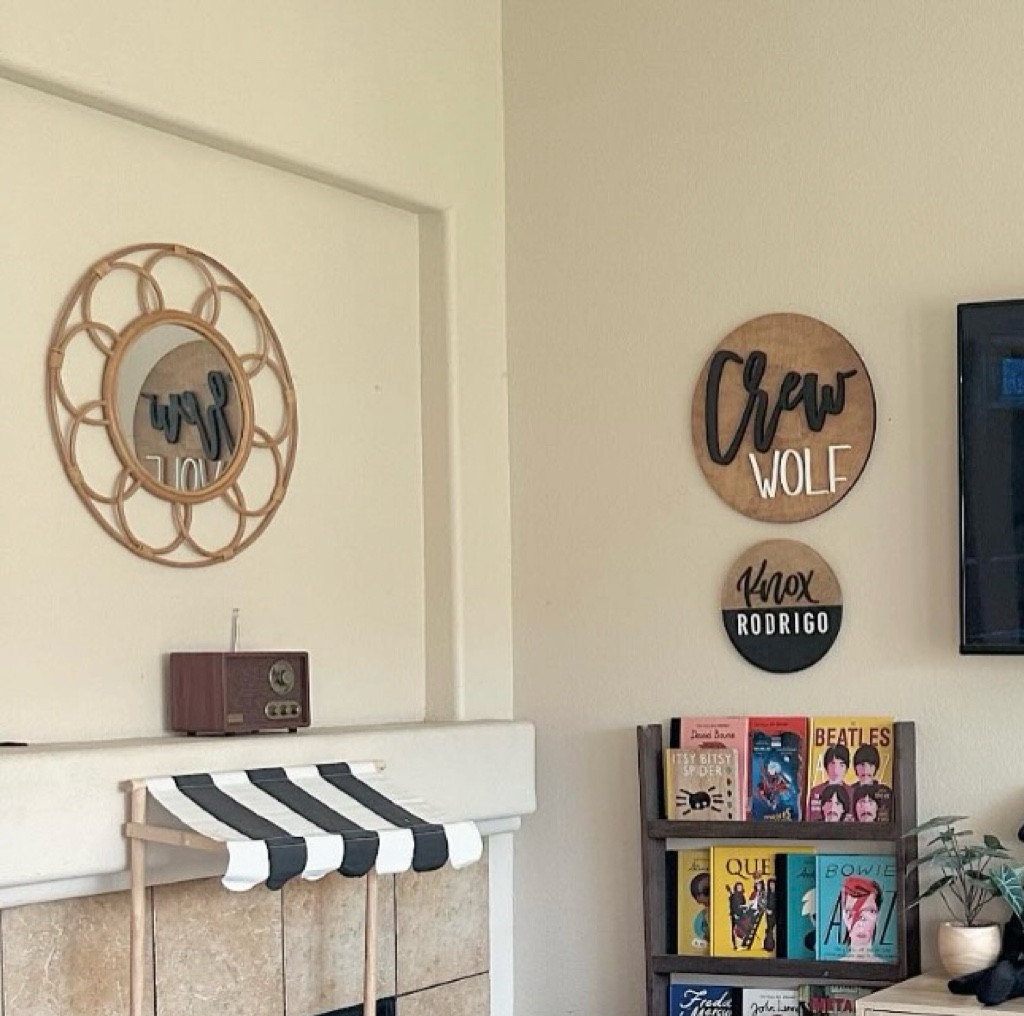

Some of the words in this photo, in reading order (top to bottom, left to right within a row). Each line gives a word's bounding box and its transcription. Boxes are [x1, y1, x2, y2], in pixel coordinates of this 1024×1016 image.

[705, 349, 858, 466] Crew
[748, 445, 852, 499] WOLF
[736, 558, 820, 607] Knox
[736, 611, 830, 637] RODRIGO
[814, 726, 891, 747] BEATLES
[672, 753, 696, 765] ITSY
[700, 753, 732, 765] BITSY
[824, 863, 897, 879] BOWIE
